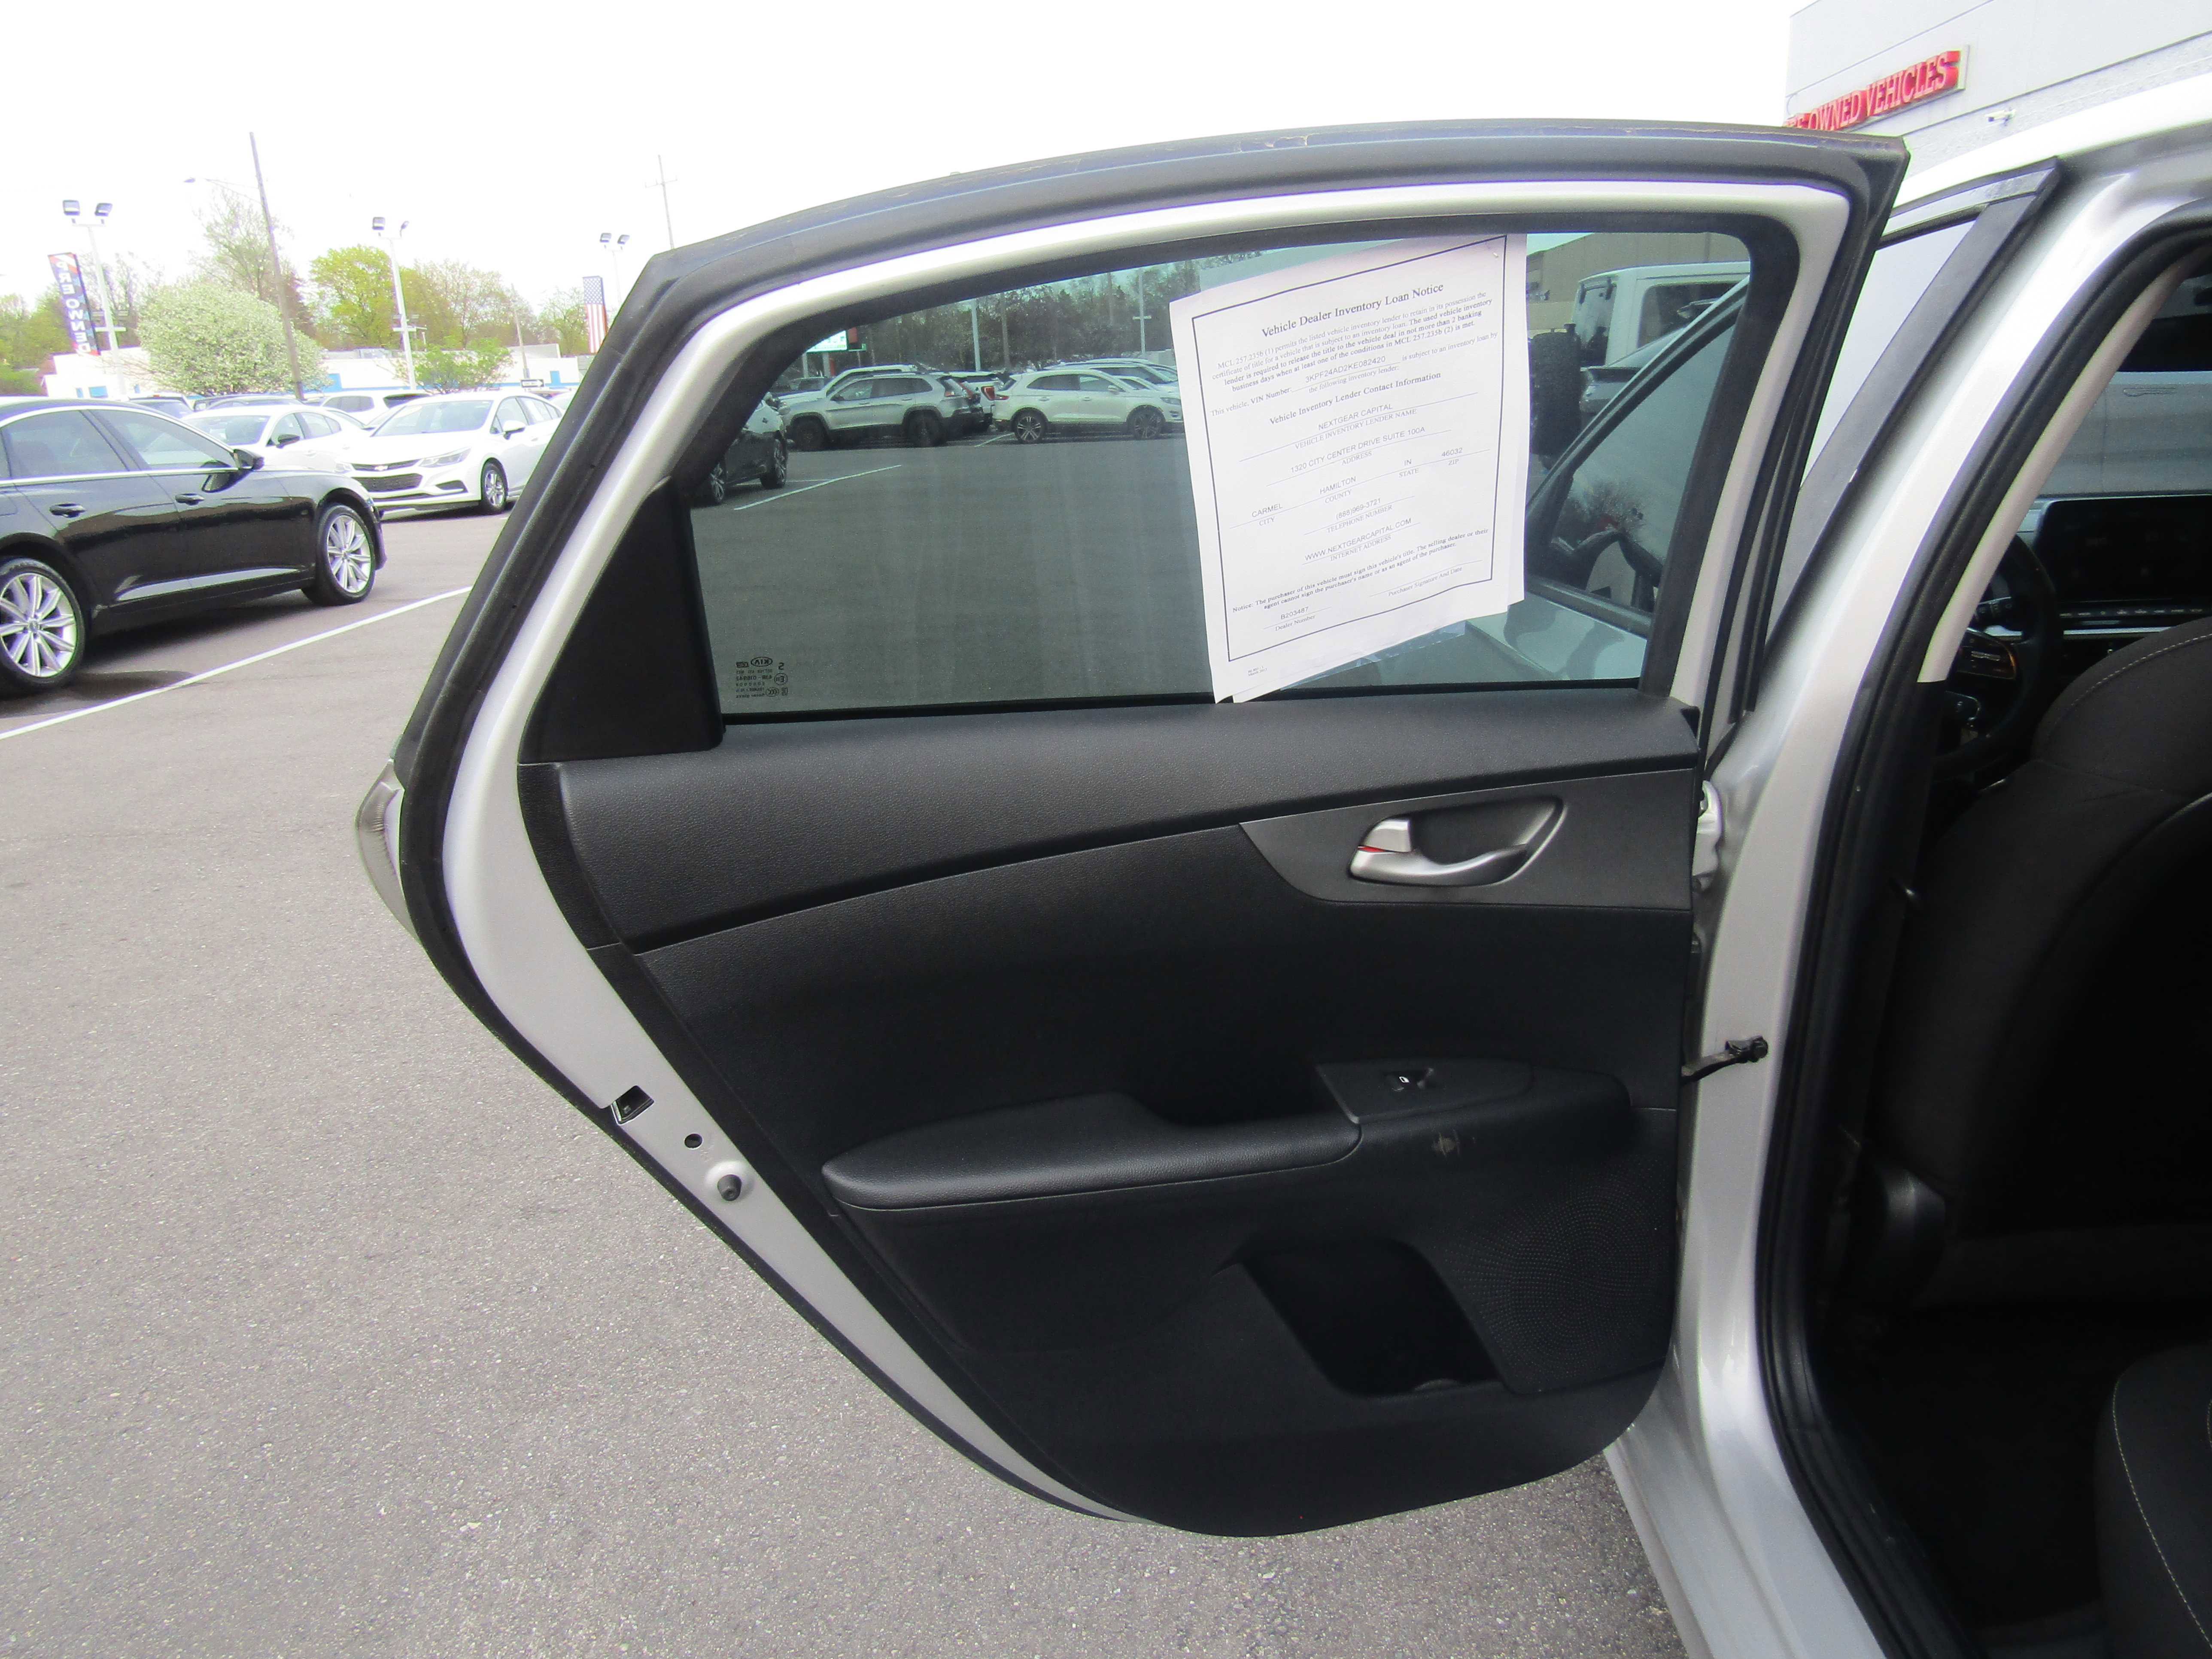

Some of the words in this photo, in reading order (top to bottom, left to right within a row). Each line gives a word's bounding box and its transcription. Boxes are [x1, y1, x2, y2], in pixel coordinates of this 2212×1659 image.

[1808, 90, 1863, 131] OWNED
[1866, 52, 1955, 117] VEHICLES
[1261, 320, 1297, 337] Vehicle
[1299, 311, 1332, 326] Dealer
[1335, 300, 1382, 317] Inventory
[1385, 293, 1409, 305] Loan
[1412, 284, 1444, 298] Notice
[1212, 368, 1243, 380] certificate
[1252, 360, 1264, 368] title
[1280, 348, 1300, 359] vehicle
[1322, 336, 1343, 346] subject
[1361, 326, 1391, 336] inventory
[1423, 313, 1437, 322] used
[1440, 307, 1462, 317] vehicle
[1463, 298, 1492, 311] inventory
[1218, 359, 1235, 369] MCL
[1236, 350, 1264, 365] 257.235b
[1265, 347, 1274, 356] (1)
[1275, 340, 1297, 354] permits
[1309, 331, 1325, 341] listed
[1327, 326, 1349, 336] vehicle
[1351, 320, 1380, 331] inventory
[1382, 314, 1401, 323] lender
[1410, 308, 1427, 317] retain
[1445, 295, 1476, 310] possession
[1224, 375, 1244, 386] lender
[1253, 362, 1279, 377] required
[1288, 355, 1310, 365] release
[1322, 346, 1335, 354] title
[1357, 335, 1381, 345] vehicle
[1382, 331, 1396, 340] deal
[1419, 323, 1435, 332] more
[1457, 310, 1482, 321] banking
[1232, 380, 1259, 392] business
[1260, 374, 1274, 383] days
[1276, 369, 1292, 377] when
[1301, 360, 1316, 370] least
[1350, 344, 1384, 356] conditions
[1394, 336, 1411, 346] MCL
[1413, 329, 1442, 341] 257.235b
[1444, 325, 1453, 334] (2)
[1211, 408, 1224, 416] This
[1250, 395, 1264, 404] VIN
[1409, 350, 1430, 359] subject
[1448, 338, 1475, 350] inventory
[1319, 378, 1347, 390] following
[1348, 371, 1376, 381] inventory
[1269, 411, 1297, 425] Vehicle
[1298, 399, 1333, 415] Inventory
[1335, 390, 1361, 403] Lender
[1363, 382, 1393, 395] Contact
[1396, 373, 1441, 388] Information
[1295, 434, 1324, 449] VEHICLE
[1325, 421, 1364, 439] INVENTORY
[1365, 413, 1393, 426] LENDER
[1395, 408, 1417, 418] NAME
[1318, 412, 1359, 431] NEXTGEAR
[1361, 404, 1393, 416] CAPITAL
[1291, 462, 1307, 473] 1320
[1308, 456, 1325, 467] CITY
[1327, 444, 1356, 460] CENTER
[1358, 437, 1380, 449] DRIVE
[1382, 430, 1405, 442] SUITE
[1408, 426, 1425, 435] 100A
[1342, 450, 1372, 465] ADDRESS
[1441, 447, 1463, 457] 46032
[1320, 476, 1356, 495] HAMILTON
[1399, 468, 1419, 478] STATE
[1252, 503, 1283, 518] CARMEL
[1325, 489, 1352, 504] COUNTY
[1336, 498, 1380, 520] (888)969-3721
[1259, 516, 1275, 526] CITY
[1326, 515, 1364, 533] TELEPHONE
[1365, 504, 1392, 519] NUMBER
[1305, 517, 1411, 561] WWW.NEXTGEARCAPITAL.COM
[1331, 546, 1362, 561] INTERNET
[1363, 535, 1392, 550] ADDRESS
[1233, 603, 1254, 613] Notice:
[1267, 590, 1296, 603] purchaser
[1317, 577, 1337, 586] vehicle
[1338, 571, 1352, 580] must
[1379, 554, 1401, 566] vehicle's
[1428, 539, 1446, 548] selling
[1264, 601, 1279, 609] agent
[1281, 594, 1300, 604] cannot
[1325, 577, 1357, 591] purchaser's
[1396, 557, 1411, 567] agent
[1388, 585, 1413, 597] Purchaser
[1414, 576, 1438, 588] Signature
[1439, 571, 1449, 579] And
[1275, 623, 1293, 631] Dealer
[1294, 615, 1316, 625] Number
[1280, 606, 1309, 620] B203487
